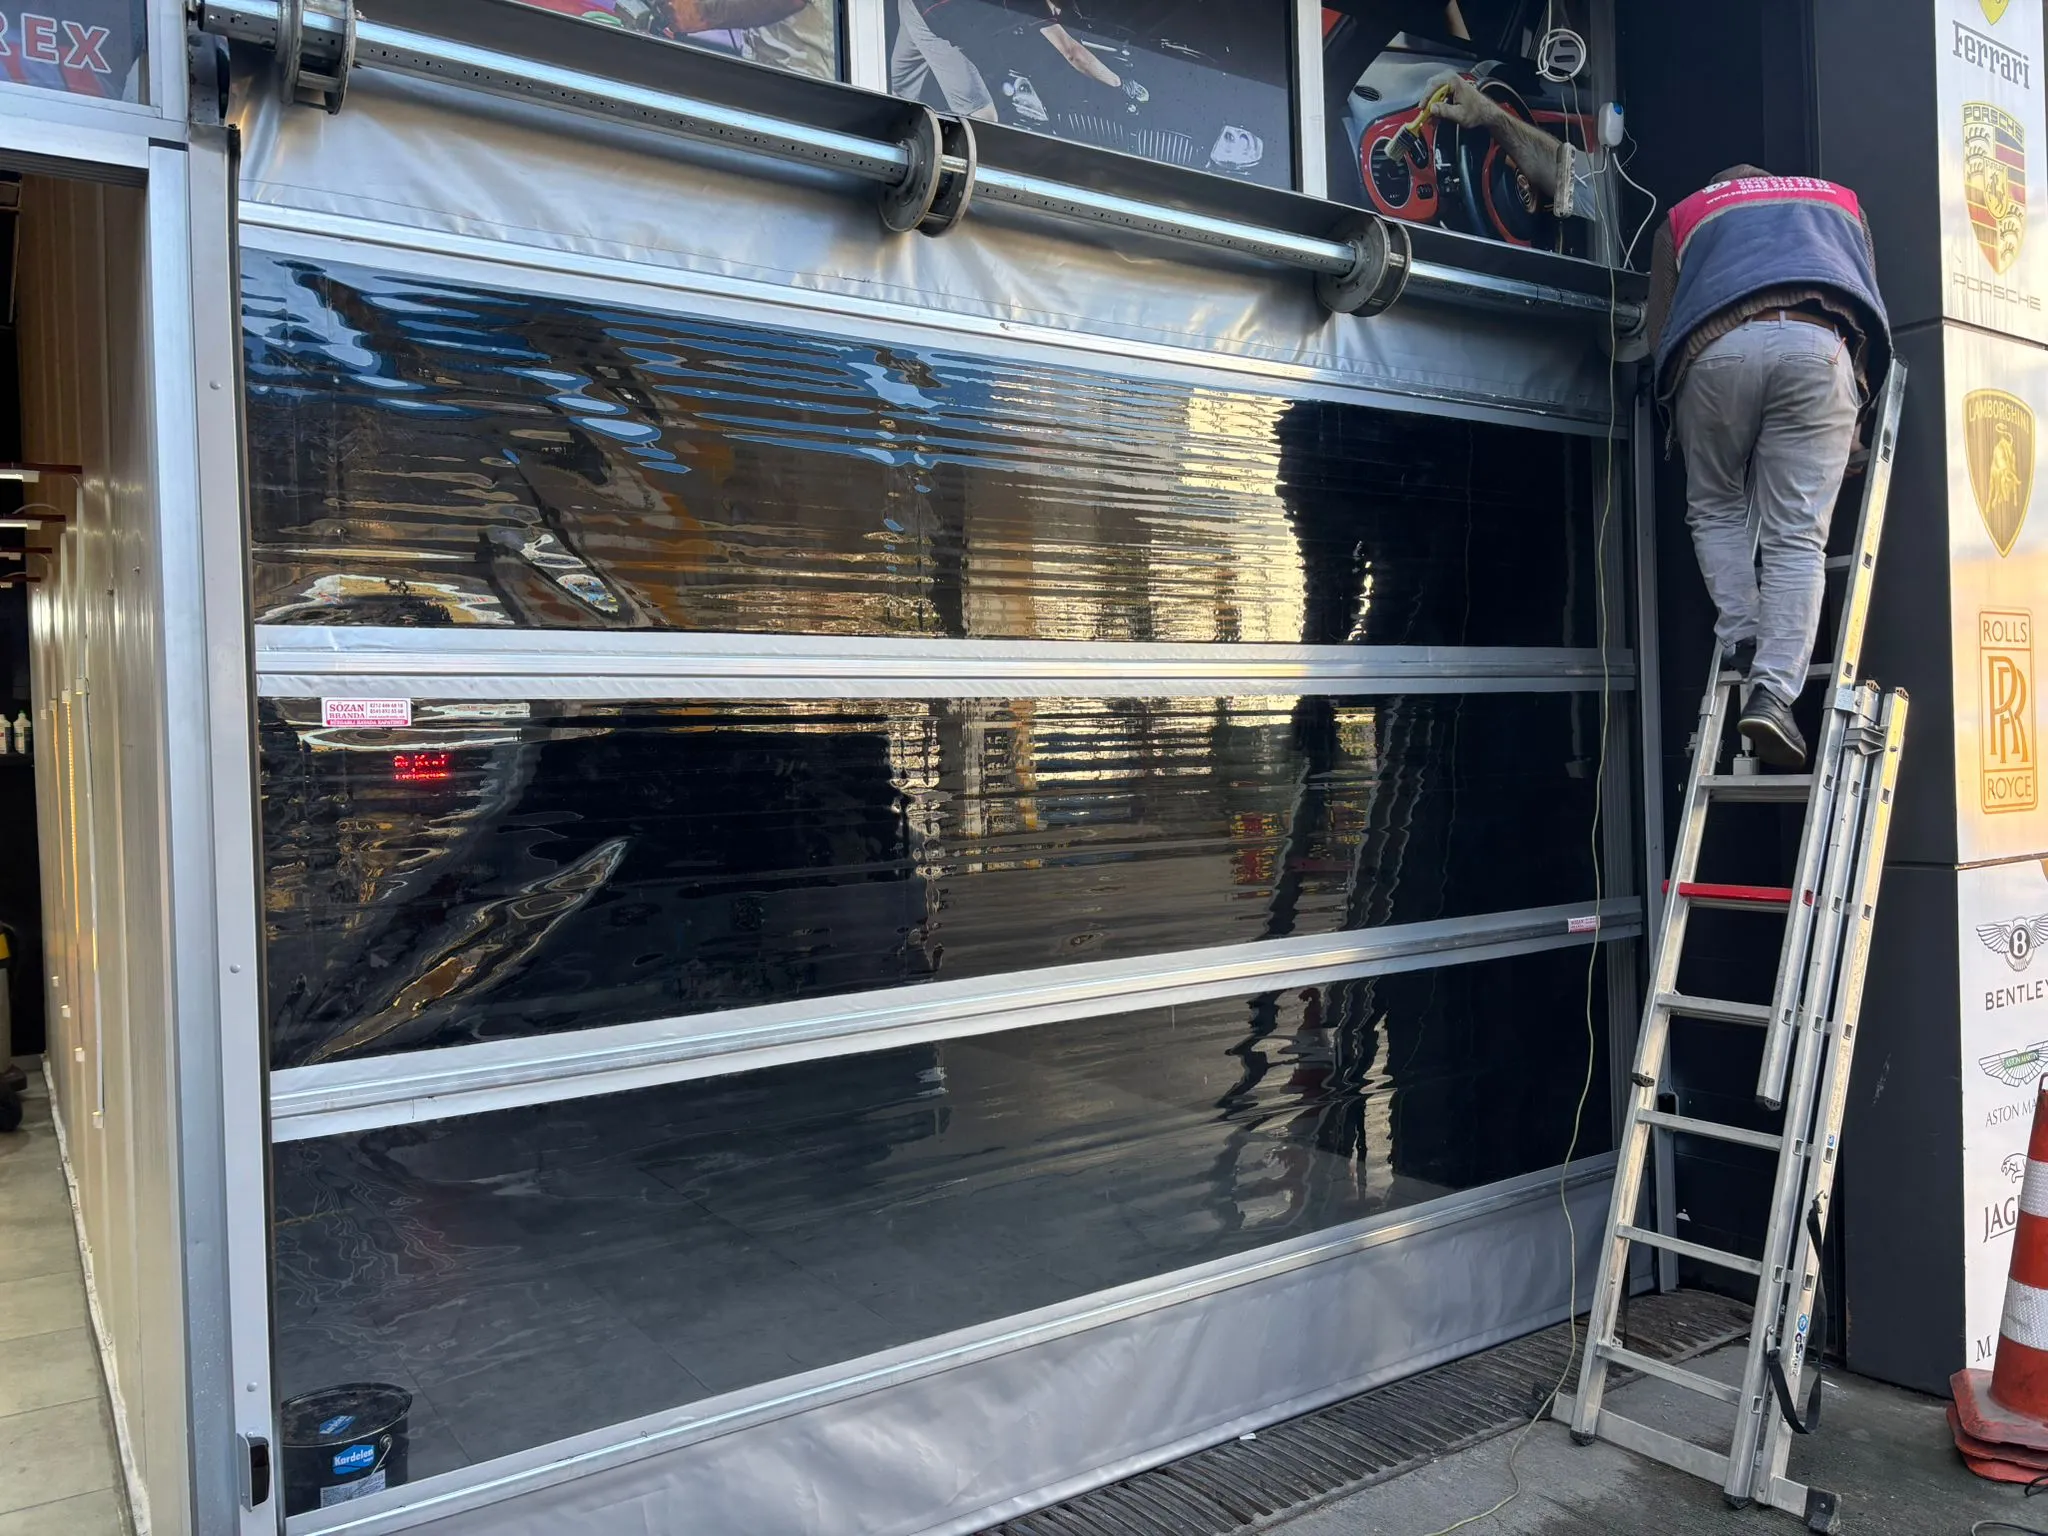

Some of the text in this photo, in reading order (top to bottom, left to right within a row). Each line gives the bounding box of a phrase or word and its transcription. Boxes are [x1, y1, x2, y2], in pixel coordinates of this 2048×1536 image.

[1952, 19, 2030, 90] Ferrari
[1964, 106, 2023, 144] PORSCHE
[1953, 272, 2041, 311] PORSCHE
[1969, 399, 2029, 434] LAMBORGHINI
[1983, 620, 2027, 643] ROLLS
[329, 702, 365, 712] SÖZAN
[1987, 776, 2032, 800] ROYCE
[1985, 1103, 2019, 1128] ASTON
[1976, 1334, 1992, 1362] M
